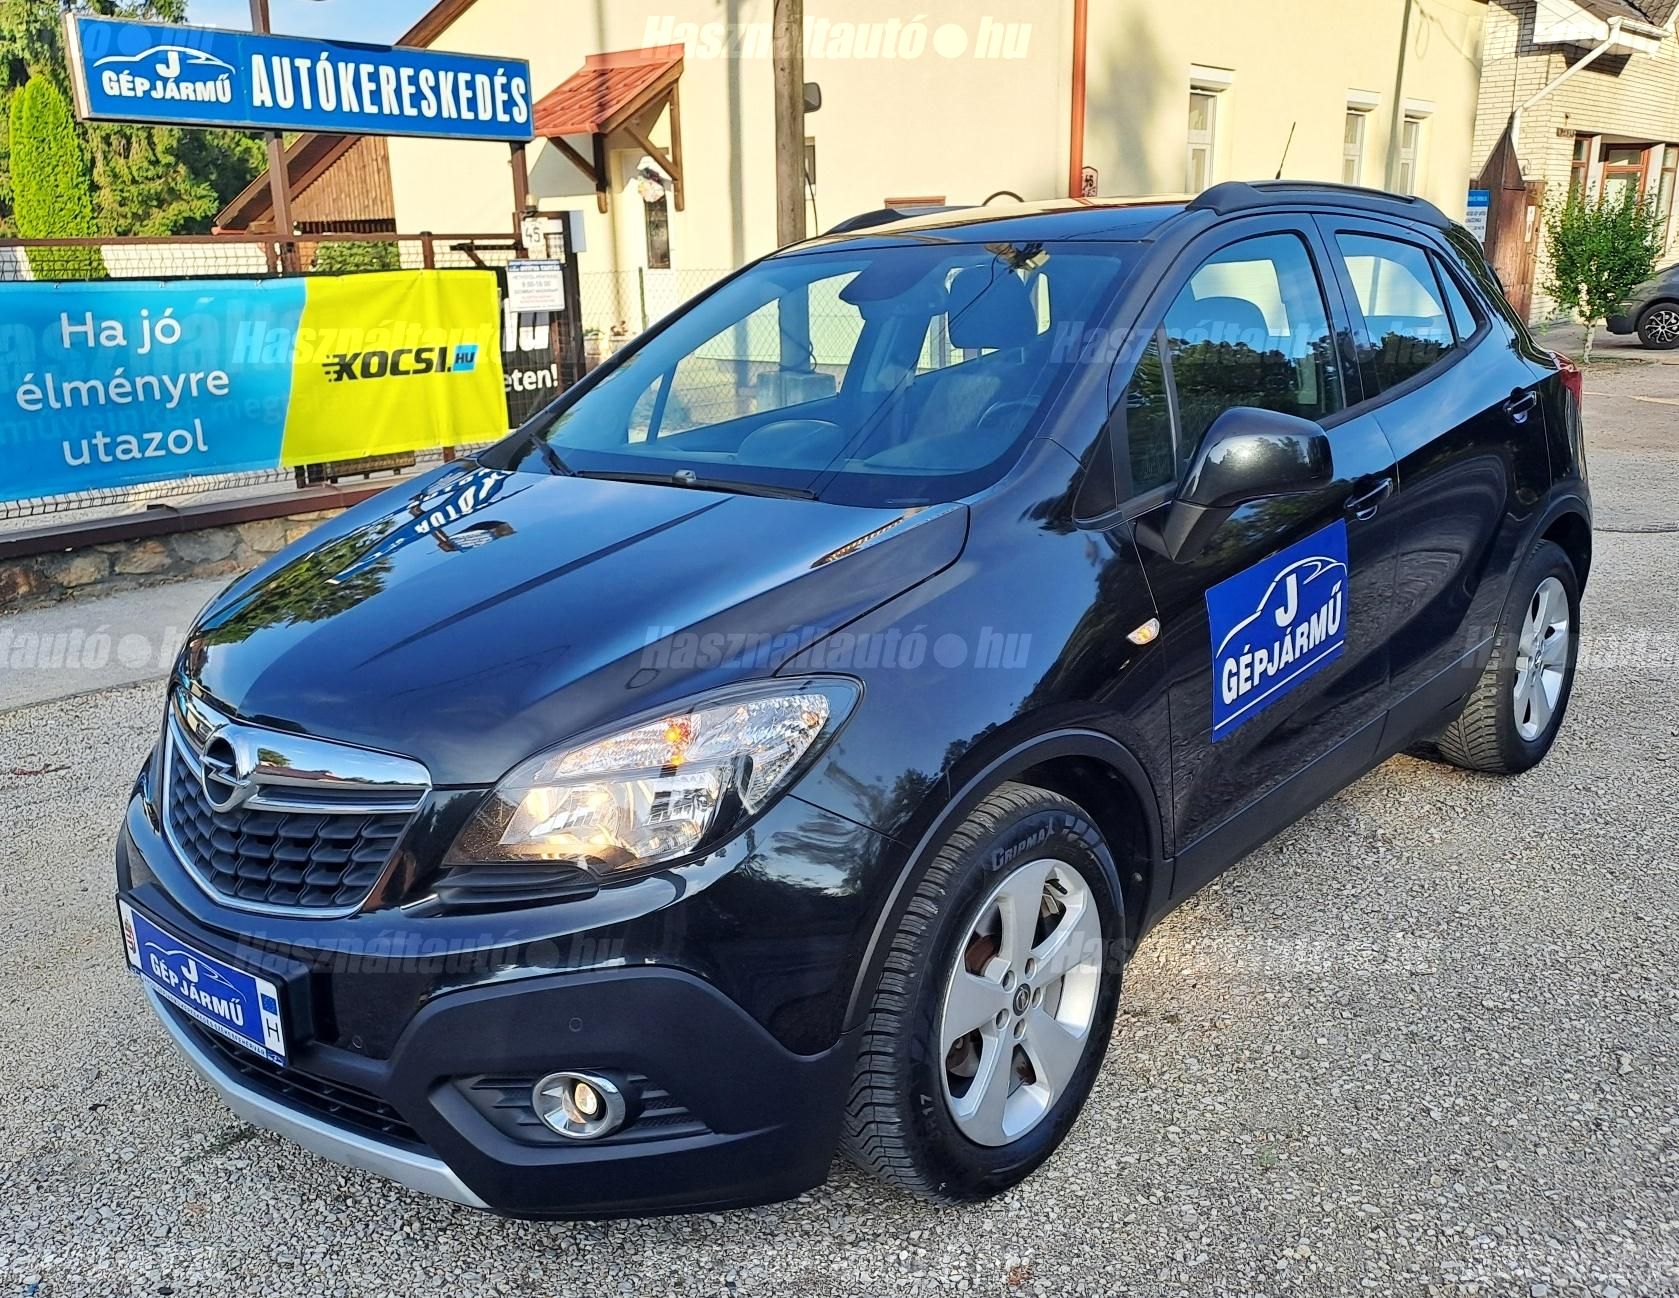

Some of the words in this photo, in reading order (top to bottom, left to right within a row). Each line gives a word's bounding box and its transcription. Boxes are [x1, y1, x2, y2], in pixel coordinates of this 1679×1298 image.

[155, 51, 181, 78] J
[251, 51, 528, 124] AUTÓKERESKEDÉS
[60, 311, 128, 349] Ha
[137, 307, 182, 354] jó
[16, 367, 230, 411] élményre
[62, 418, 208, 466] utazol
[1275, 573, 1298, 627] J
[1222, 580, 1342, 704] GÉPJÁRMŰ
[180, 958, 199, 983] J
[265, 1018, 280, 1043] H
